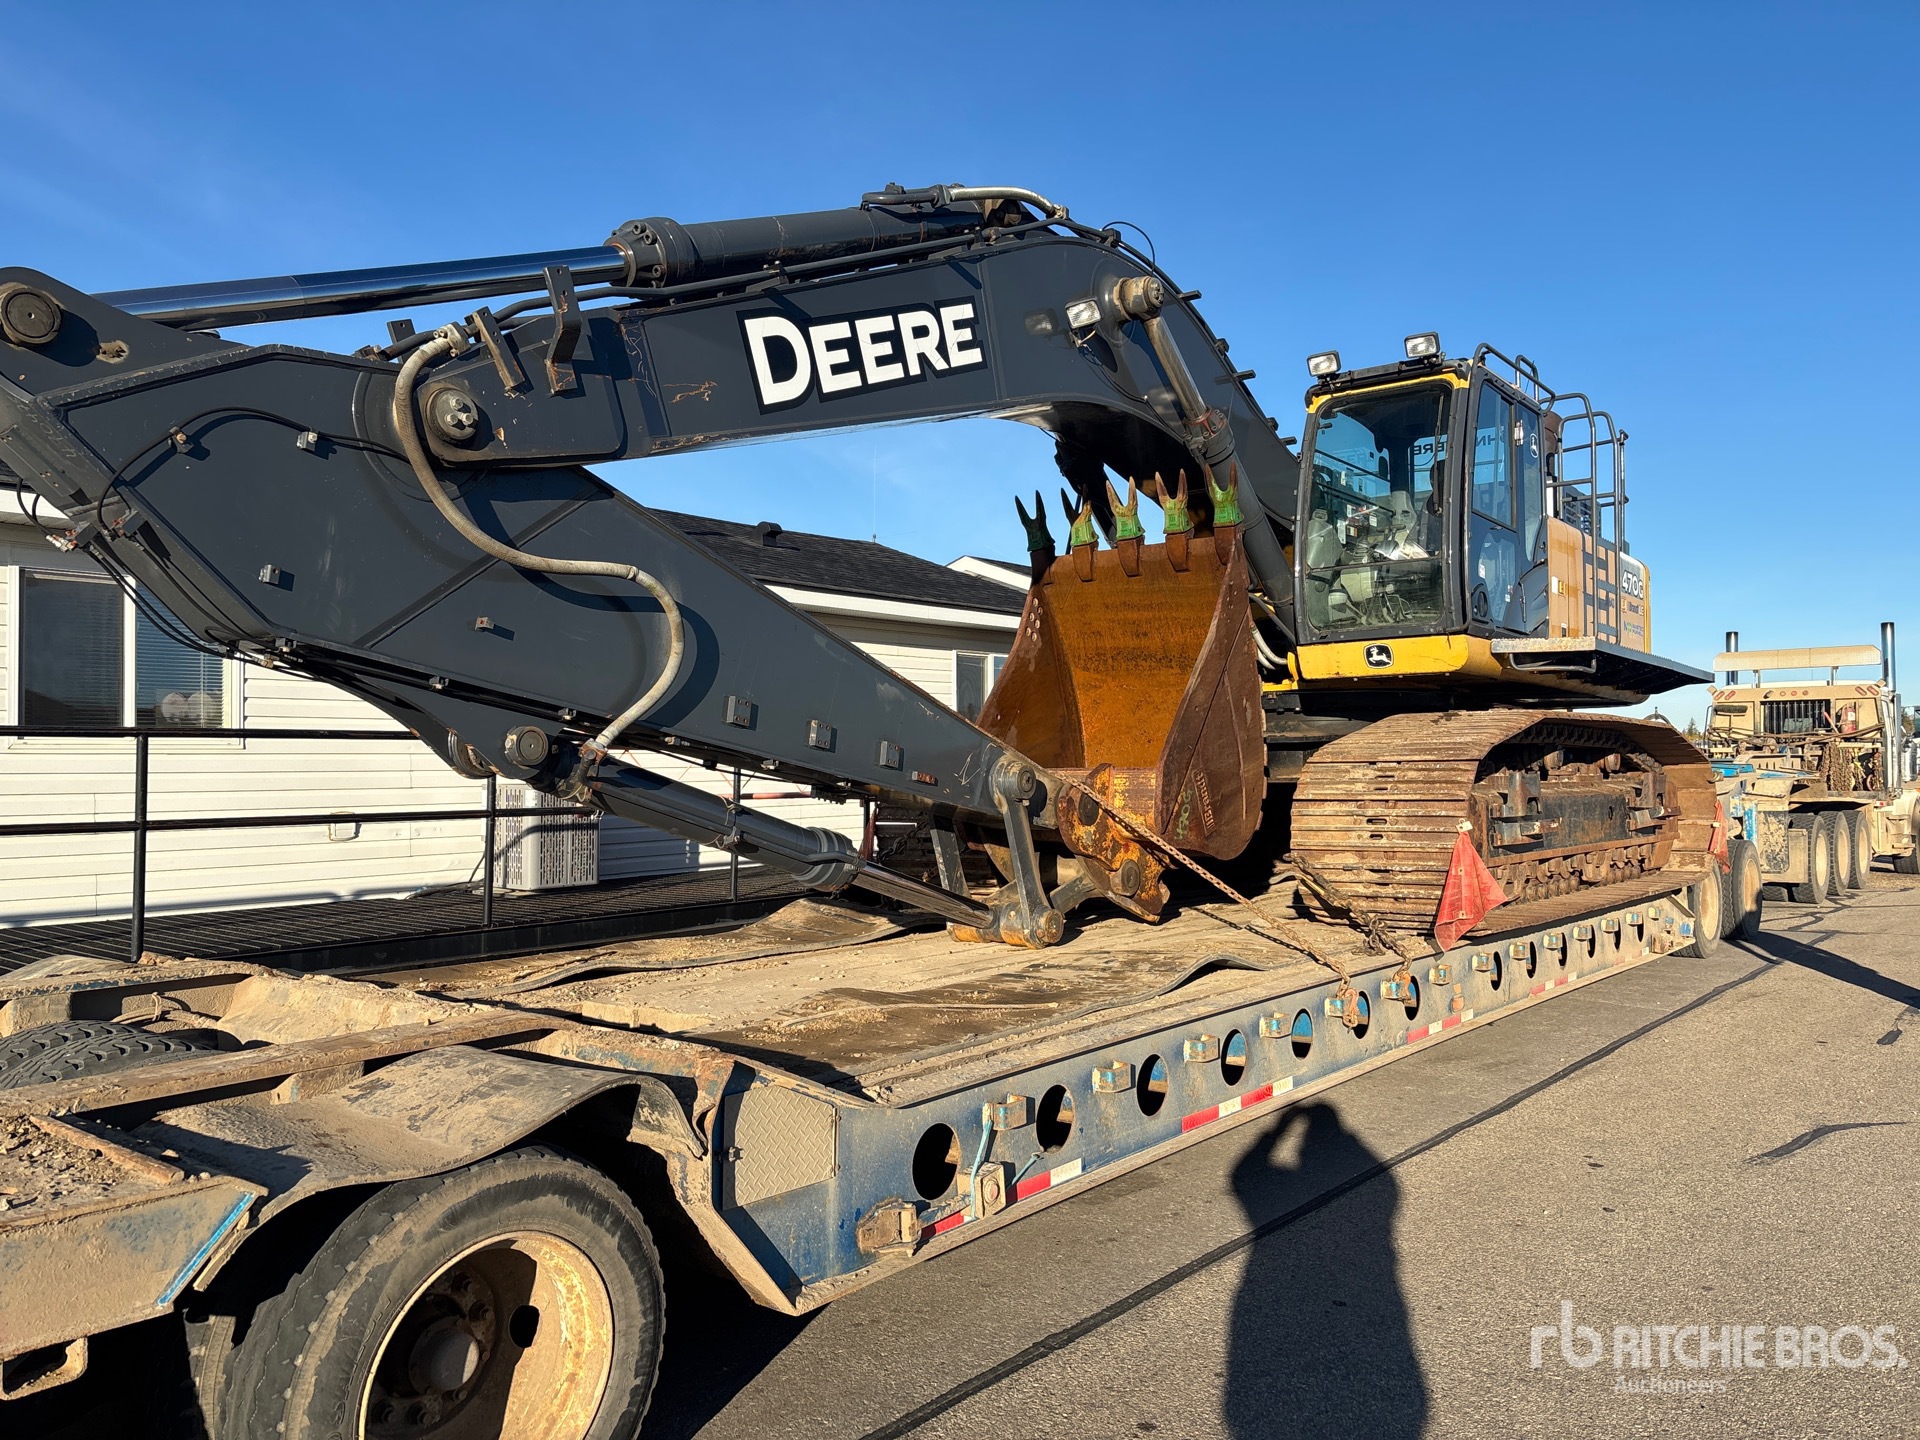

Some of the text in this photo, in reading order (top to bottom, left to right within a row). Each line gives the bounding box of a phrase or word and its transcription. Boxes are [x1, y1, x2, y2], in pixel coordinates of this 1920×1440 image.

[744, 303, 982, 405] DEERE
[1622, 571, 1644, 599] 470G
[1195, 772, 1215, 821] Brandt
